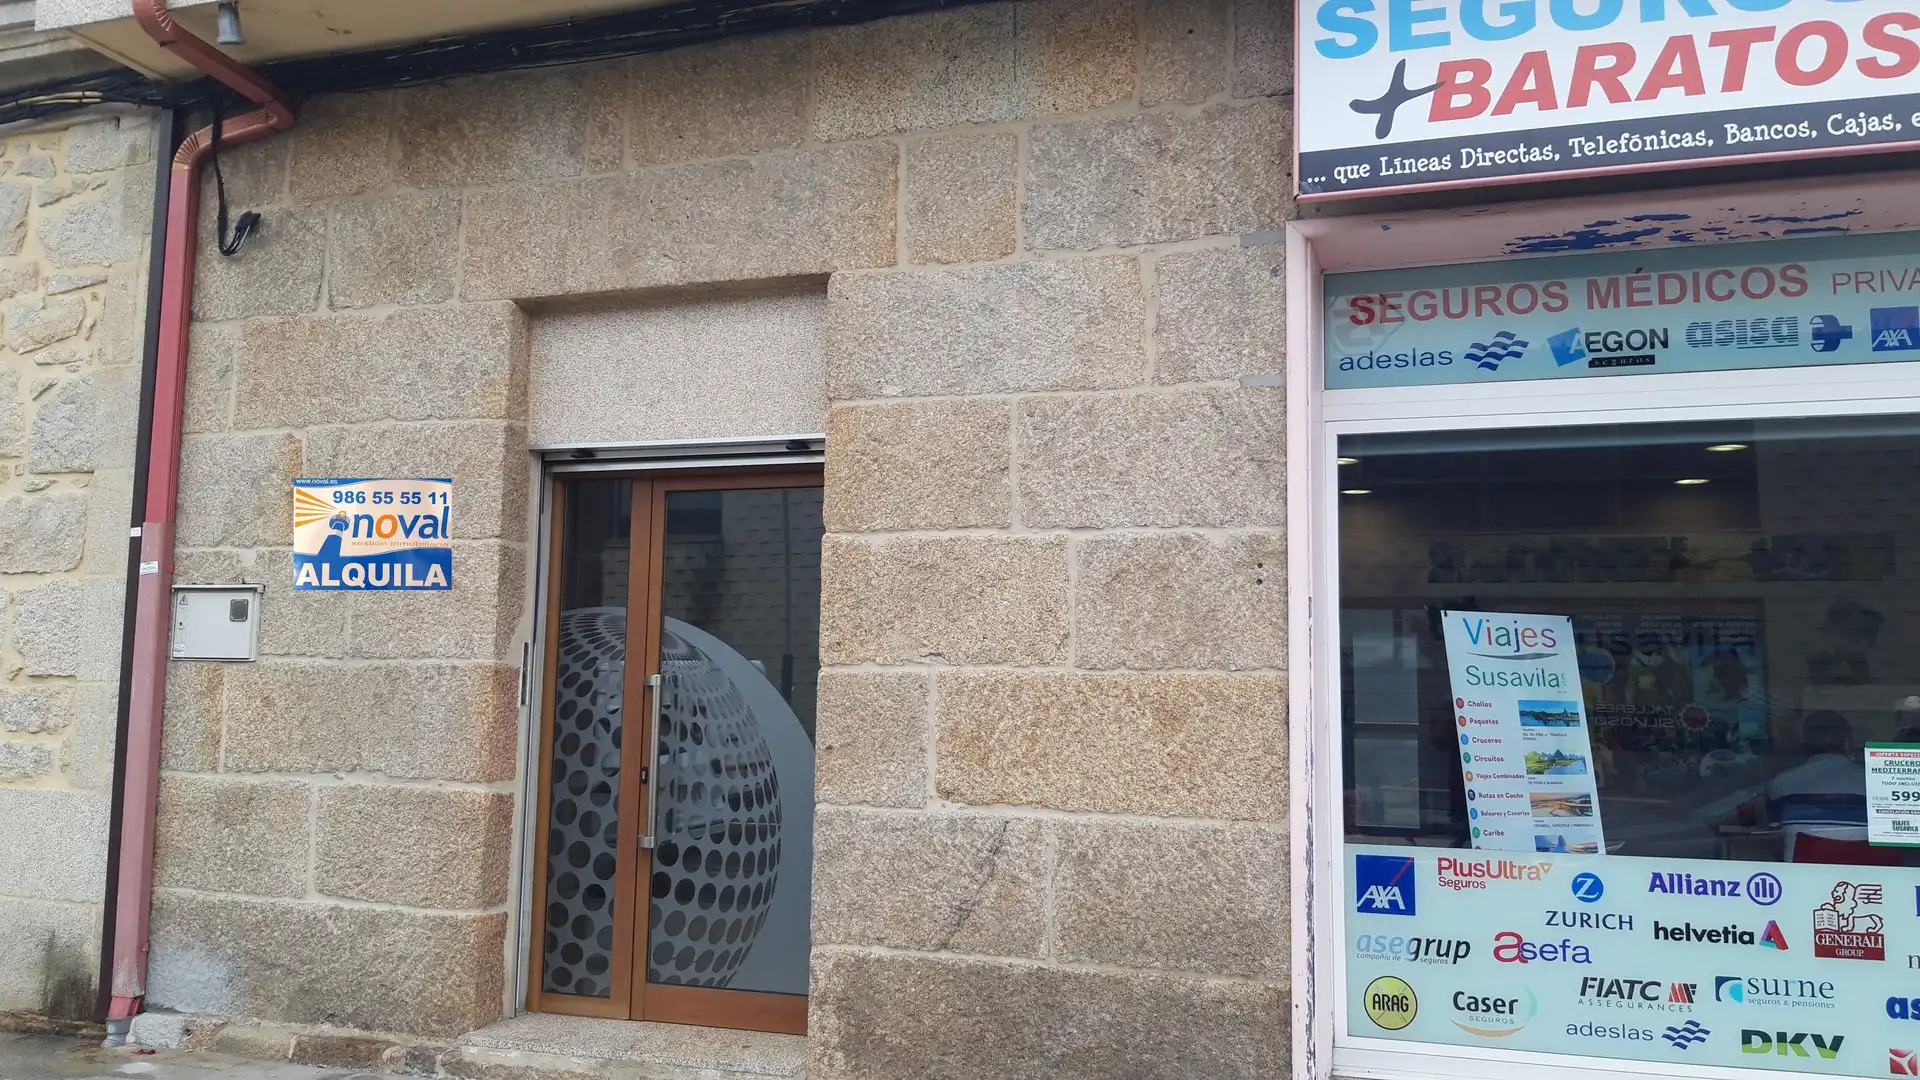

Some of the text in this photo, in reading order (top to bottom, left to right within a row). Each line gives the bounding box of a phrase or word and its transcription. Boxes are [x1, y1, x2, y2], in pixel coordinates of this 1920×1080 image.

[1333, 162, 1371, 184] que
[1460, 144, 1560, 170] Directas,
[1724, 119, 1818, 145] Bancos,
[1826, 112, 1902, 137] Cajas,
[1349, 279, 1569, 326] SEGUROS
[1586, 263, 1809, 310] MÉDICOS
[1569, 327, 1669, 354] AEGON
[1685, 316, 1799, 349] asisa
[1872, 329, 1913, 348] AXA
[1339, 347, 1454, 372] adeslas
[333, 490, 447, 505] 986 55 55 11
[352, 505, 450, 540] noval
[295, 562, 448, 589] ALQUILA
[1462, 617, 1557, 653] Viajes
[1465, 665, 1560, 688] Susavila
[1467, 700, 1493, 708] Chollos
[1469, 717, 1499, 726] Paquetes
[1471, 736, 1502, 744] Cruceros
[1483, 829, 1505, 837] Caribe
[1437, 857, 1542, 881] PlusUltra
[1438, 876, 1487, 890] Seguros
[1648, 872, 1741, 897] Allianz
[1357, 885, 1406, 910] AXA
[1545, 910, 1634, 931] ZURICH
[1654, 920, 1755, 946] helvetia
[1815, 933, 1883, 949] GENERALI
[1356, 933, 1471, 965] asegrup
[1493, 931, 1593, 964] asefa
[1835, 948, 1865, 957] GROUP
[1419, 957, 1449, 965] seguros
[1580, 976, 1662, 1002] FIATC
[1747, 977, 1835, 999] surne
[1372, 992, 1409, 1013] ARAG
[1452, 990, 1519, 1015] Caser
[1578, 998, 1692, 1013] ASSEGURANCES
[1747, 998, 1781, 1006] seguros
[1791, 999, 1835, 1008] pensiones
[1468, 1015, 1515, 1025] SEGUROS
[1566, 1021, 1654, 1041] adeslas
[1741, 1028, 1845, 1060] DKV
